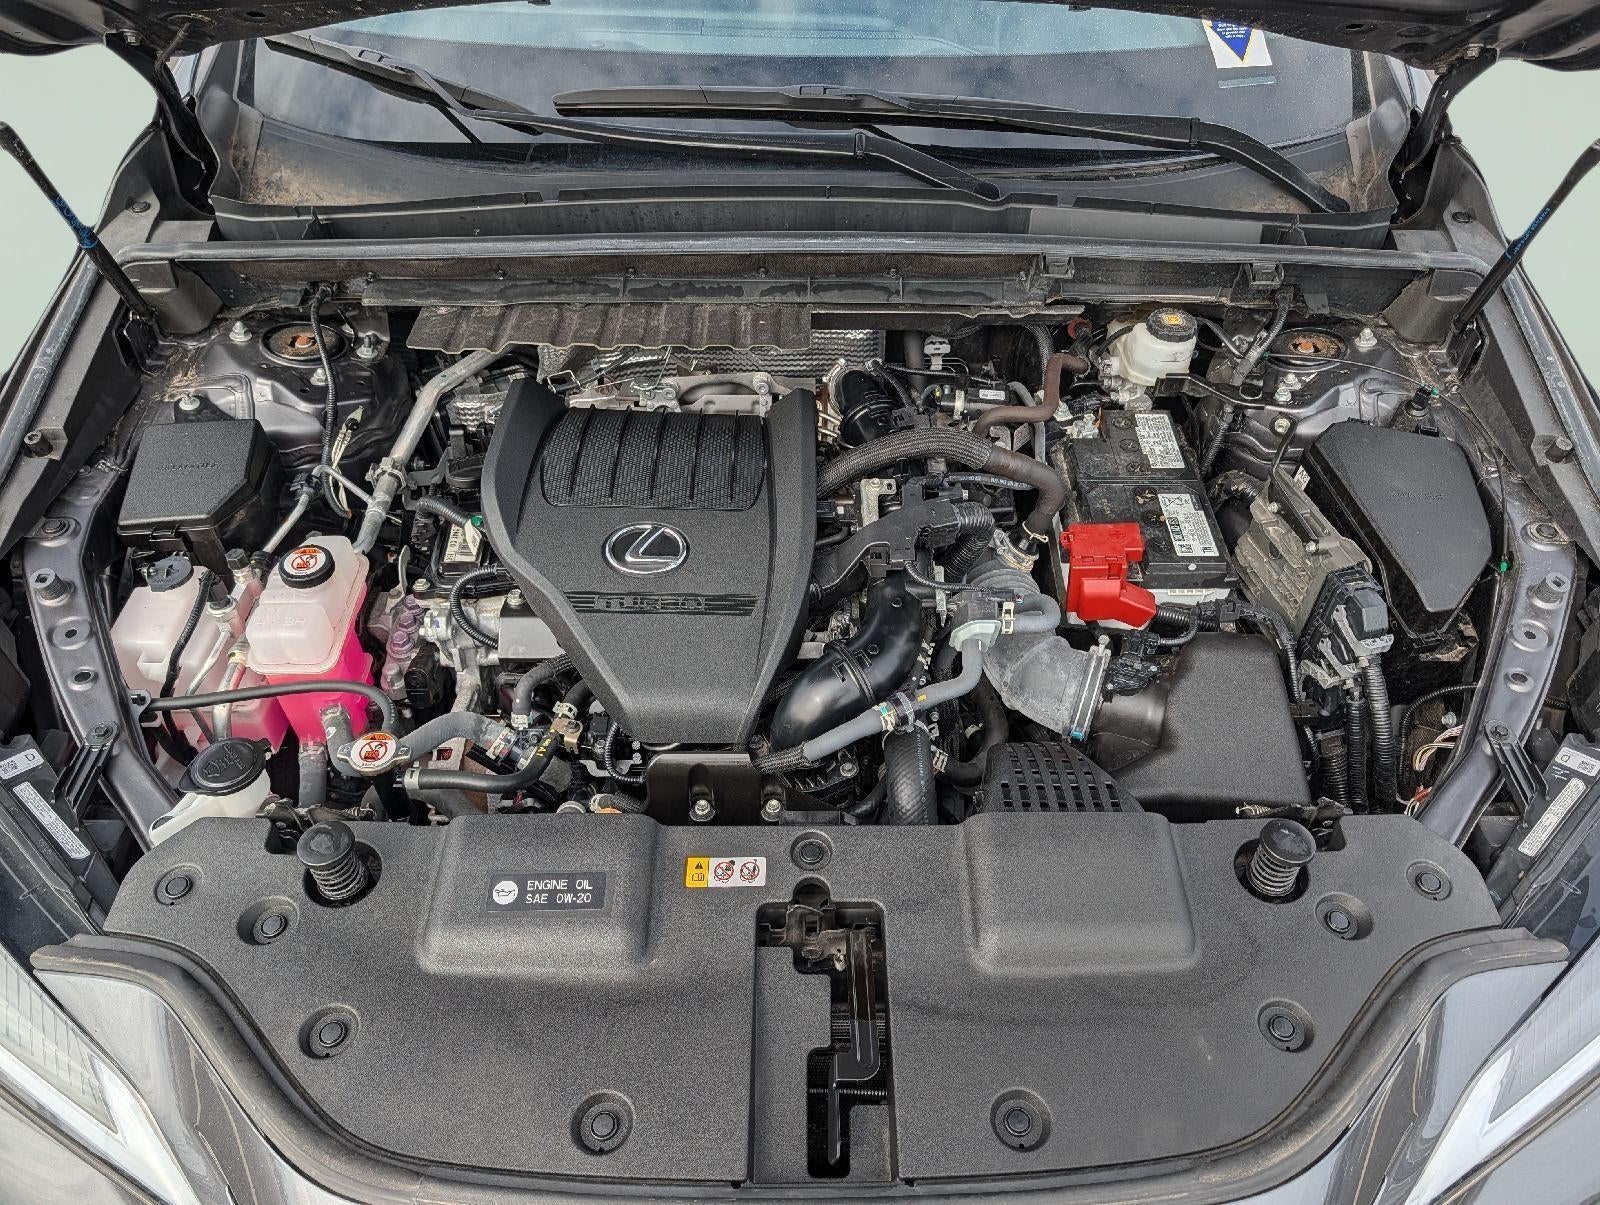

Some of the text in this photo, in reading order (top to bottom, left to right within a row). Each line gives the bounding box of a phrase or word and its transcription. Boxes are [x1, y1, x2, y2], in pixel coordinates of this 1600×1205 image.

[526, 879, 594, 891] ENGINE OIL
[525, 893, 549, 904] SAE
